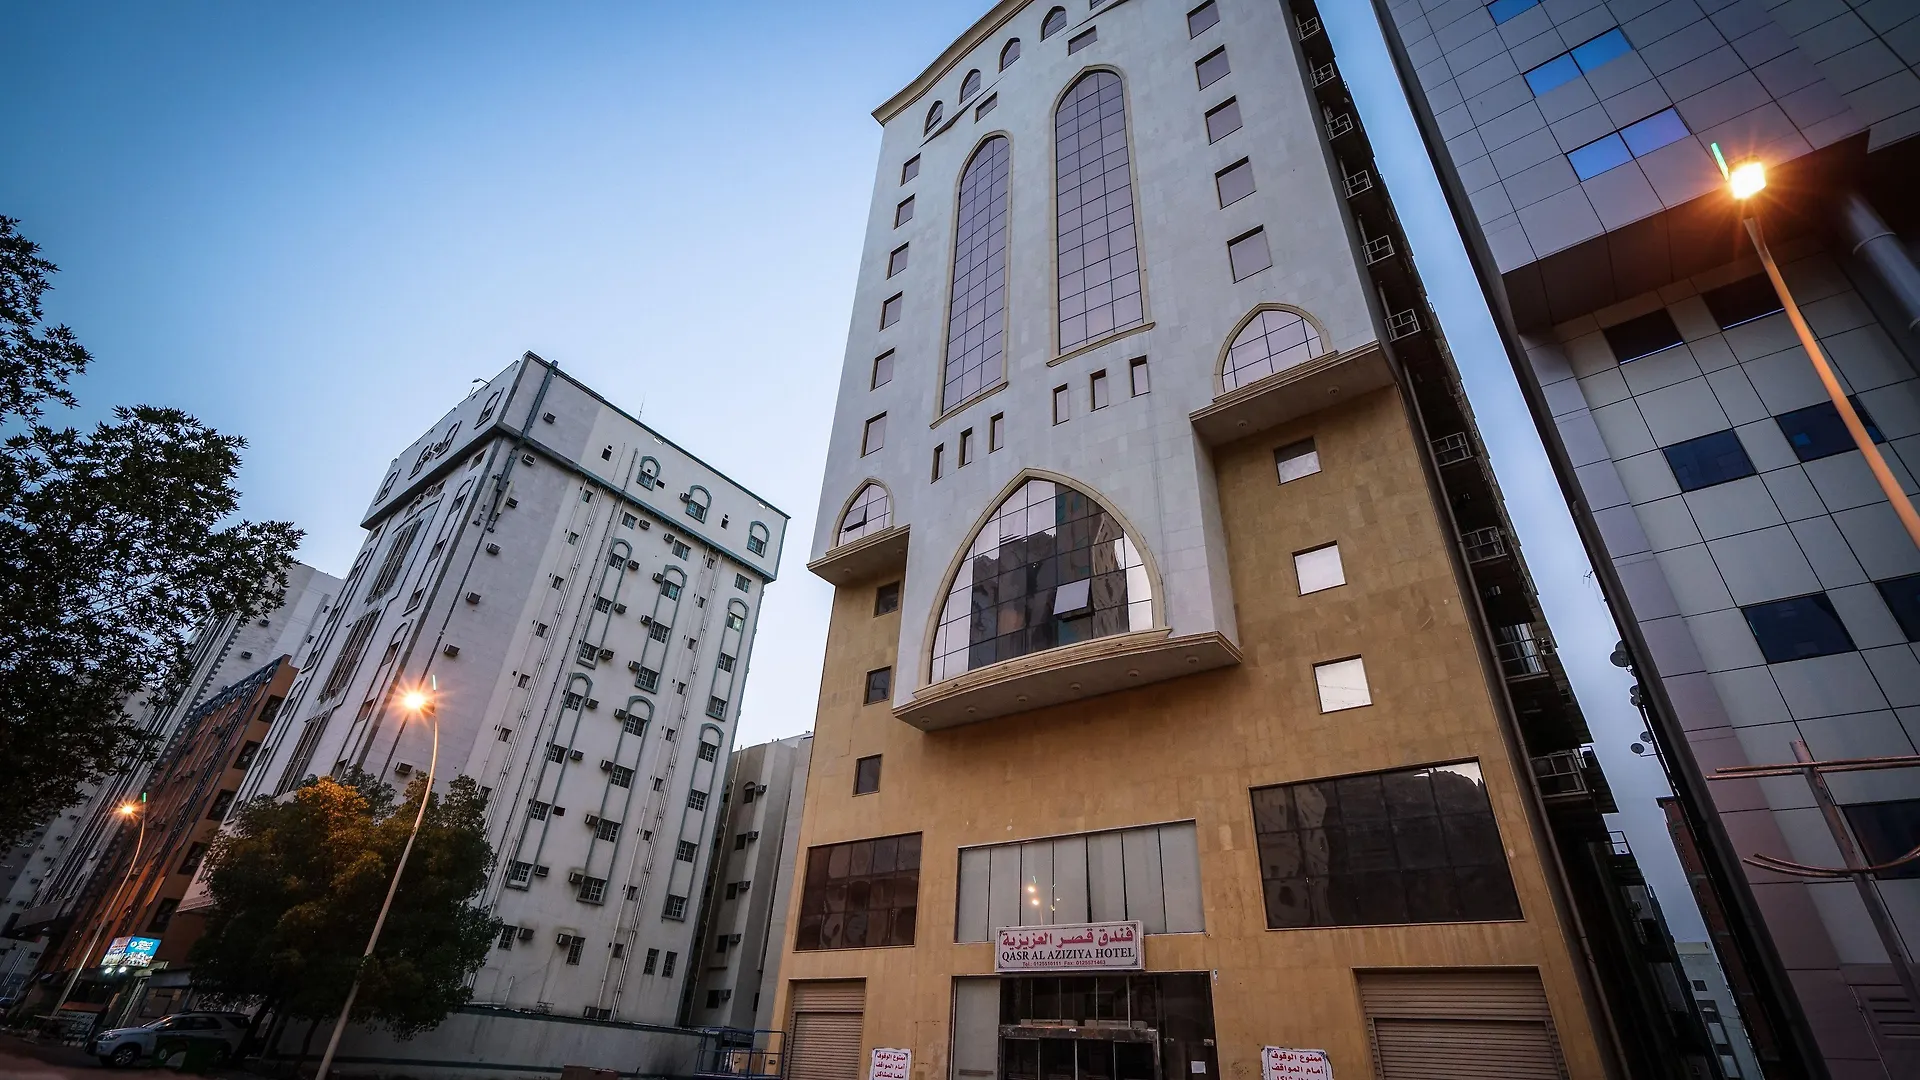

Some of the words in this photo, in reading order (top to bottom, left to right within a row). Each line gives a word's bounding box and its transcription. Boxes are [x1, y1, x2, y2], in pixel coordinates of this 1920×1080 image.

[1002, 931, 1052, 950] العزيزية
[1056, 928, 1094, 948] قصر
[1098, 927, 1133, 947] فندق
[1002, 951, 1029, 962] QASR
[1031, 950, 1045, 960] AL
[1048, 949, 1092, 960] AZIZIYA
[1095, 947, 1135, 958] HOTEL
[1271, 1051, 1297, 1061] الوقوف
[1299, 1054, 1322, 1063] ممنوع
[1271, 1063, 1303, 1073] المواقف
[1306, 1066, 1324, 1074] أمام
